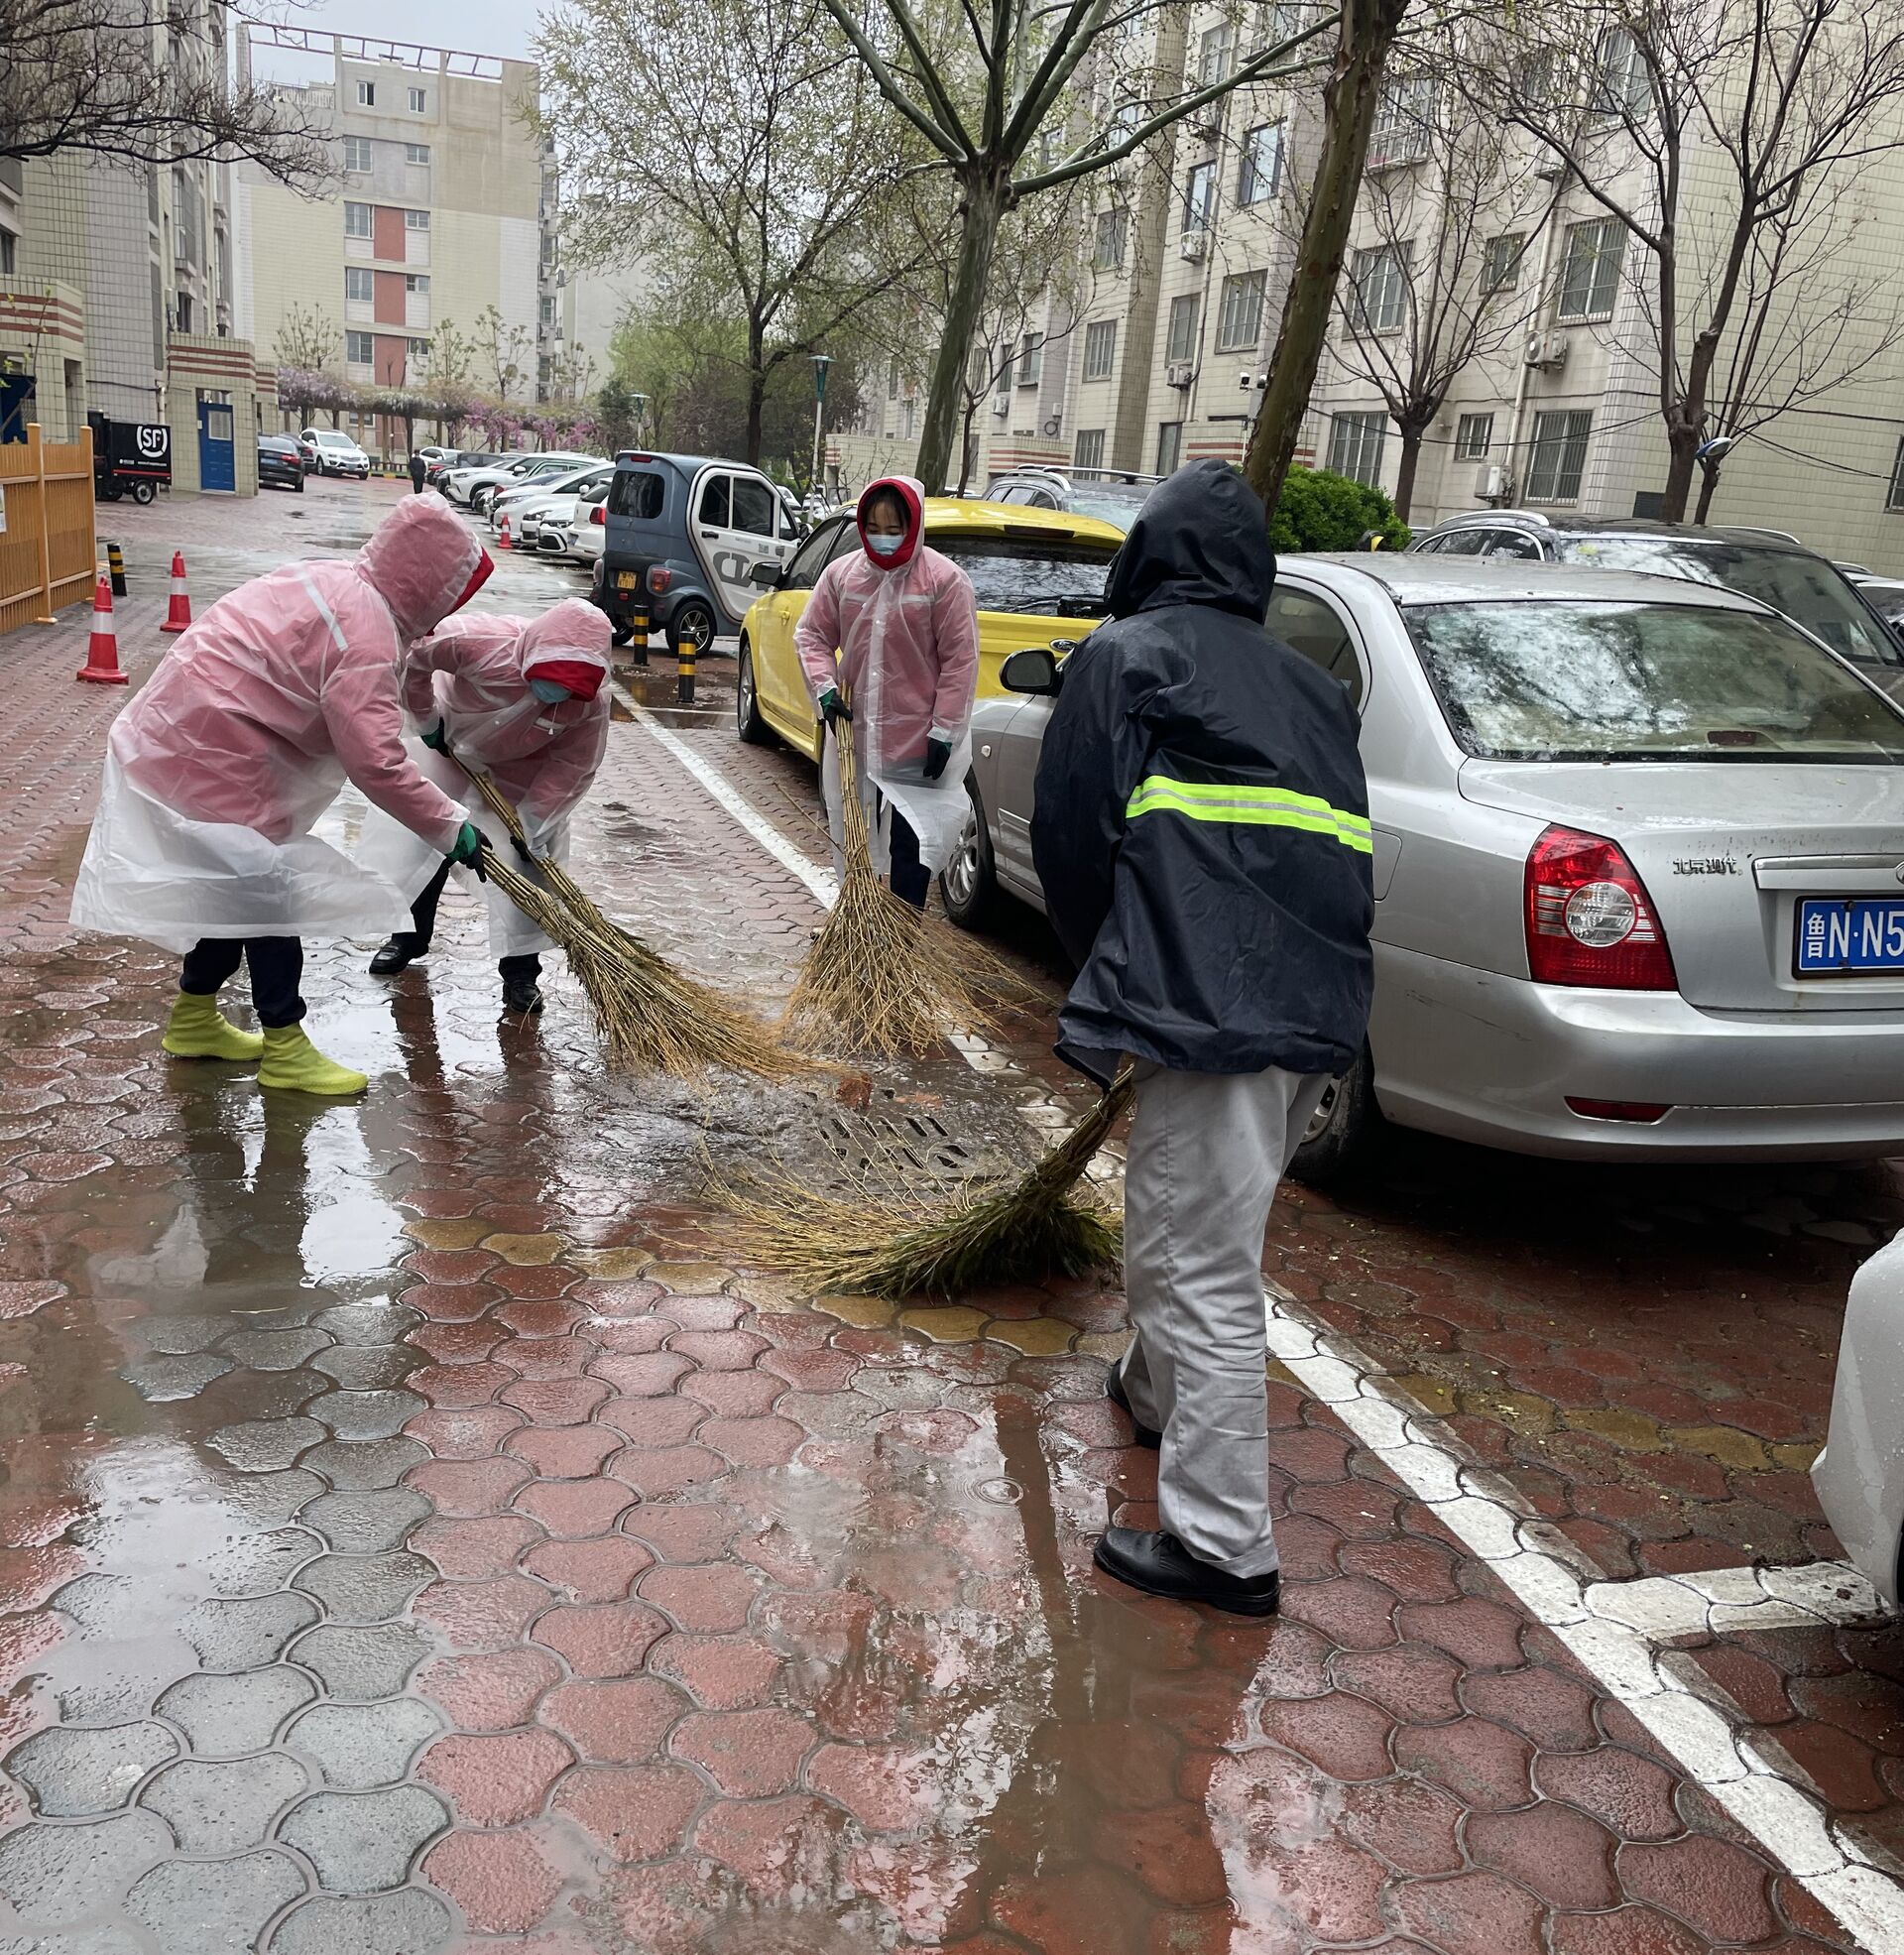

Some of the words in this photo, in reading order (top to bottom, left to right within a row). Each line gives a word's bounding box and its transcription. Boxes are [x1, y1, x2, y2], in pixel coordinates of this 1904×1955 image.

[142, 428, 162, 448] SF
[1673, 857, 1737, 875] 北京现代
